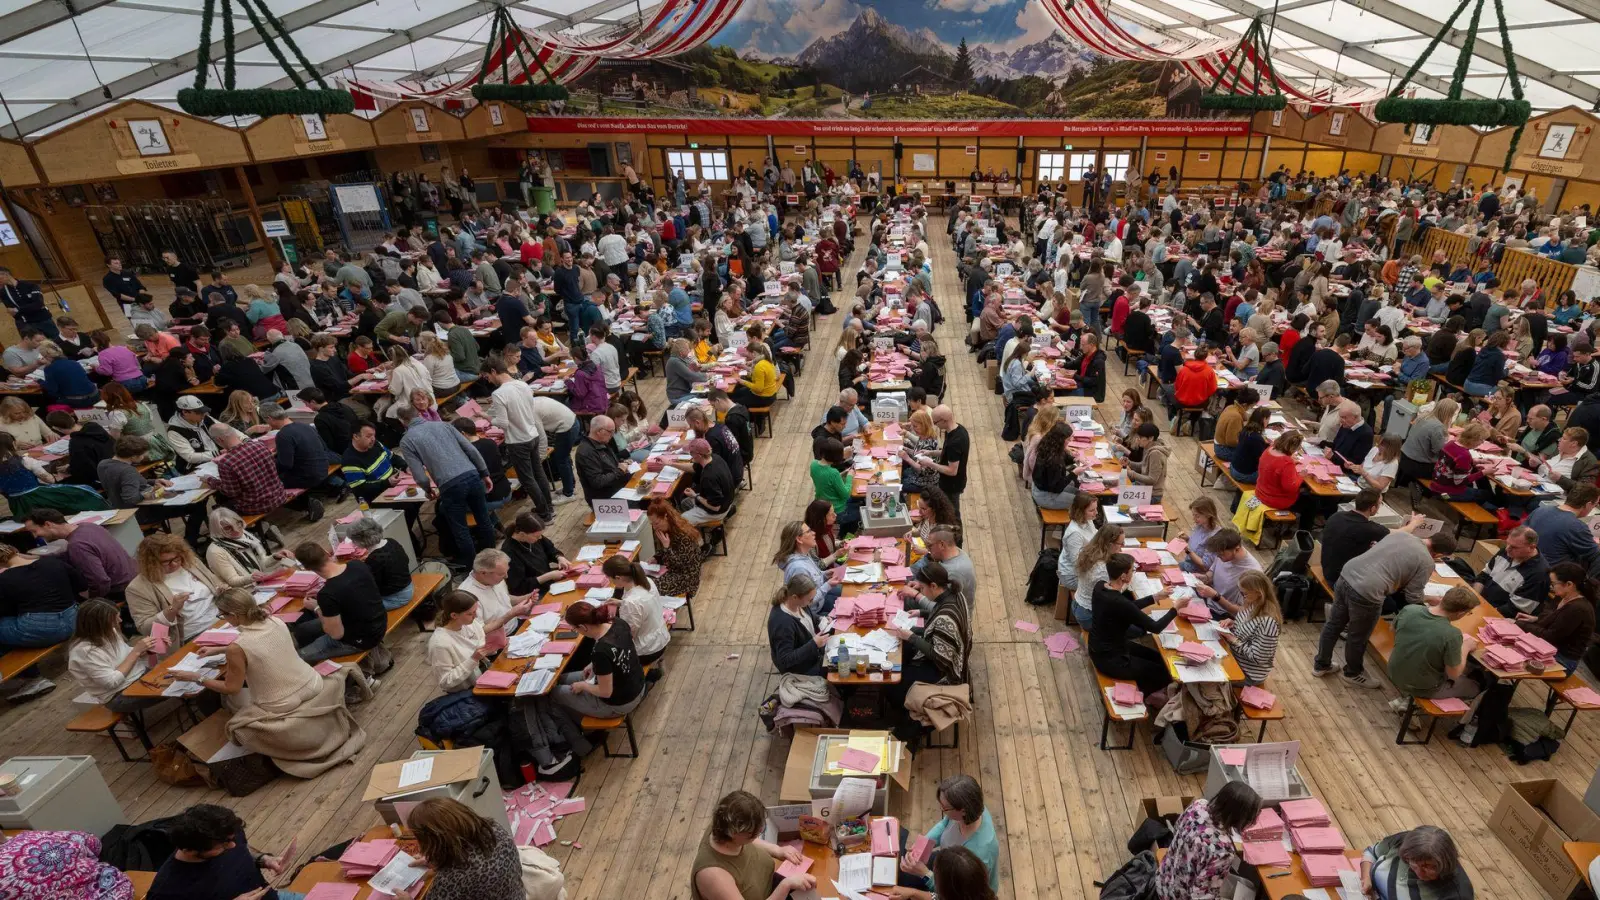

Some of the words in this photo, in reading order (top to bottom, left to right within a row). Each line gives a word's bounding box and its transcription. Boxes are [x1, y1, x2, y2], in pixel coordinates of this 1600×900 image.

[143, 160, 178, 170] Toiletten
[1531, 161, 1563, 174] Göggingen
[671, 414, 686, 422] 628
[876, 411, 896, 419] 6251
[870, 491, 890, 502] 624
[1122, 490, 1147, 501] 6241
[598, 504, 624, 514] 6282
[1510, 809, 1534, 837] Transport
